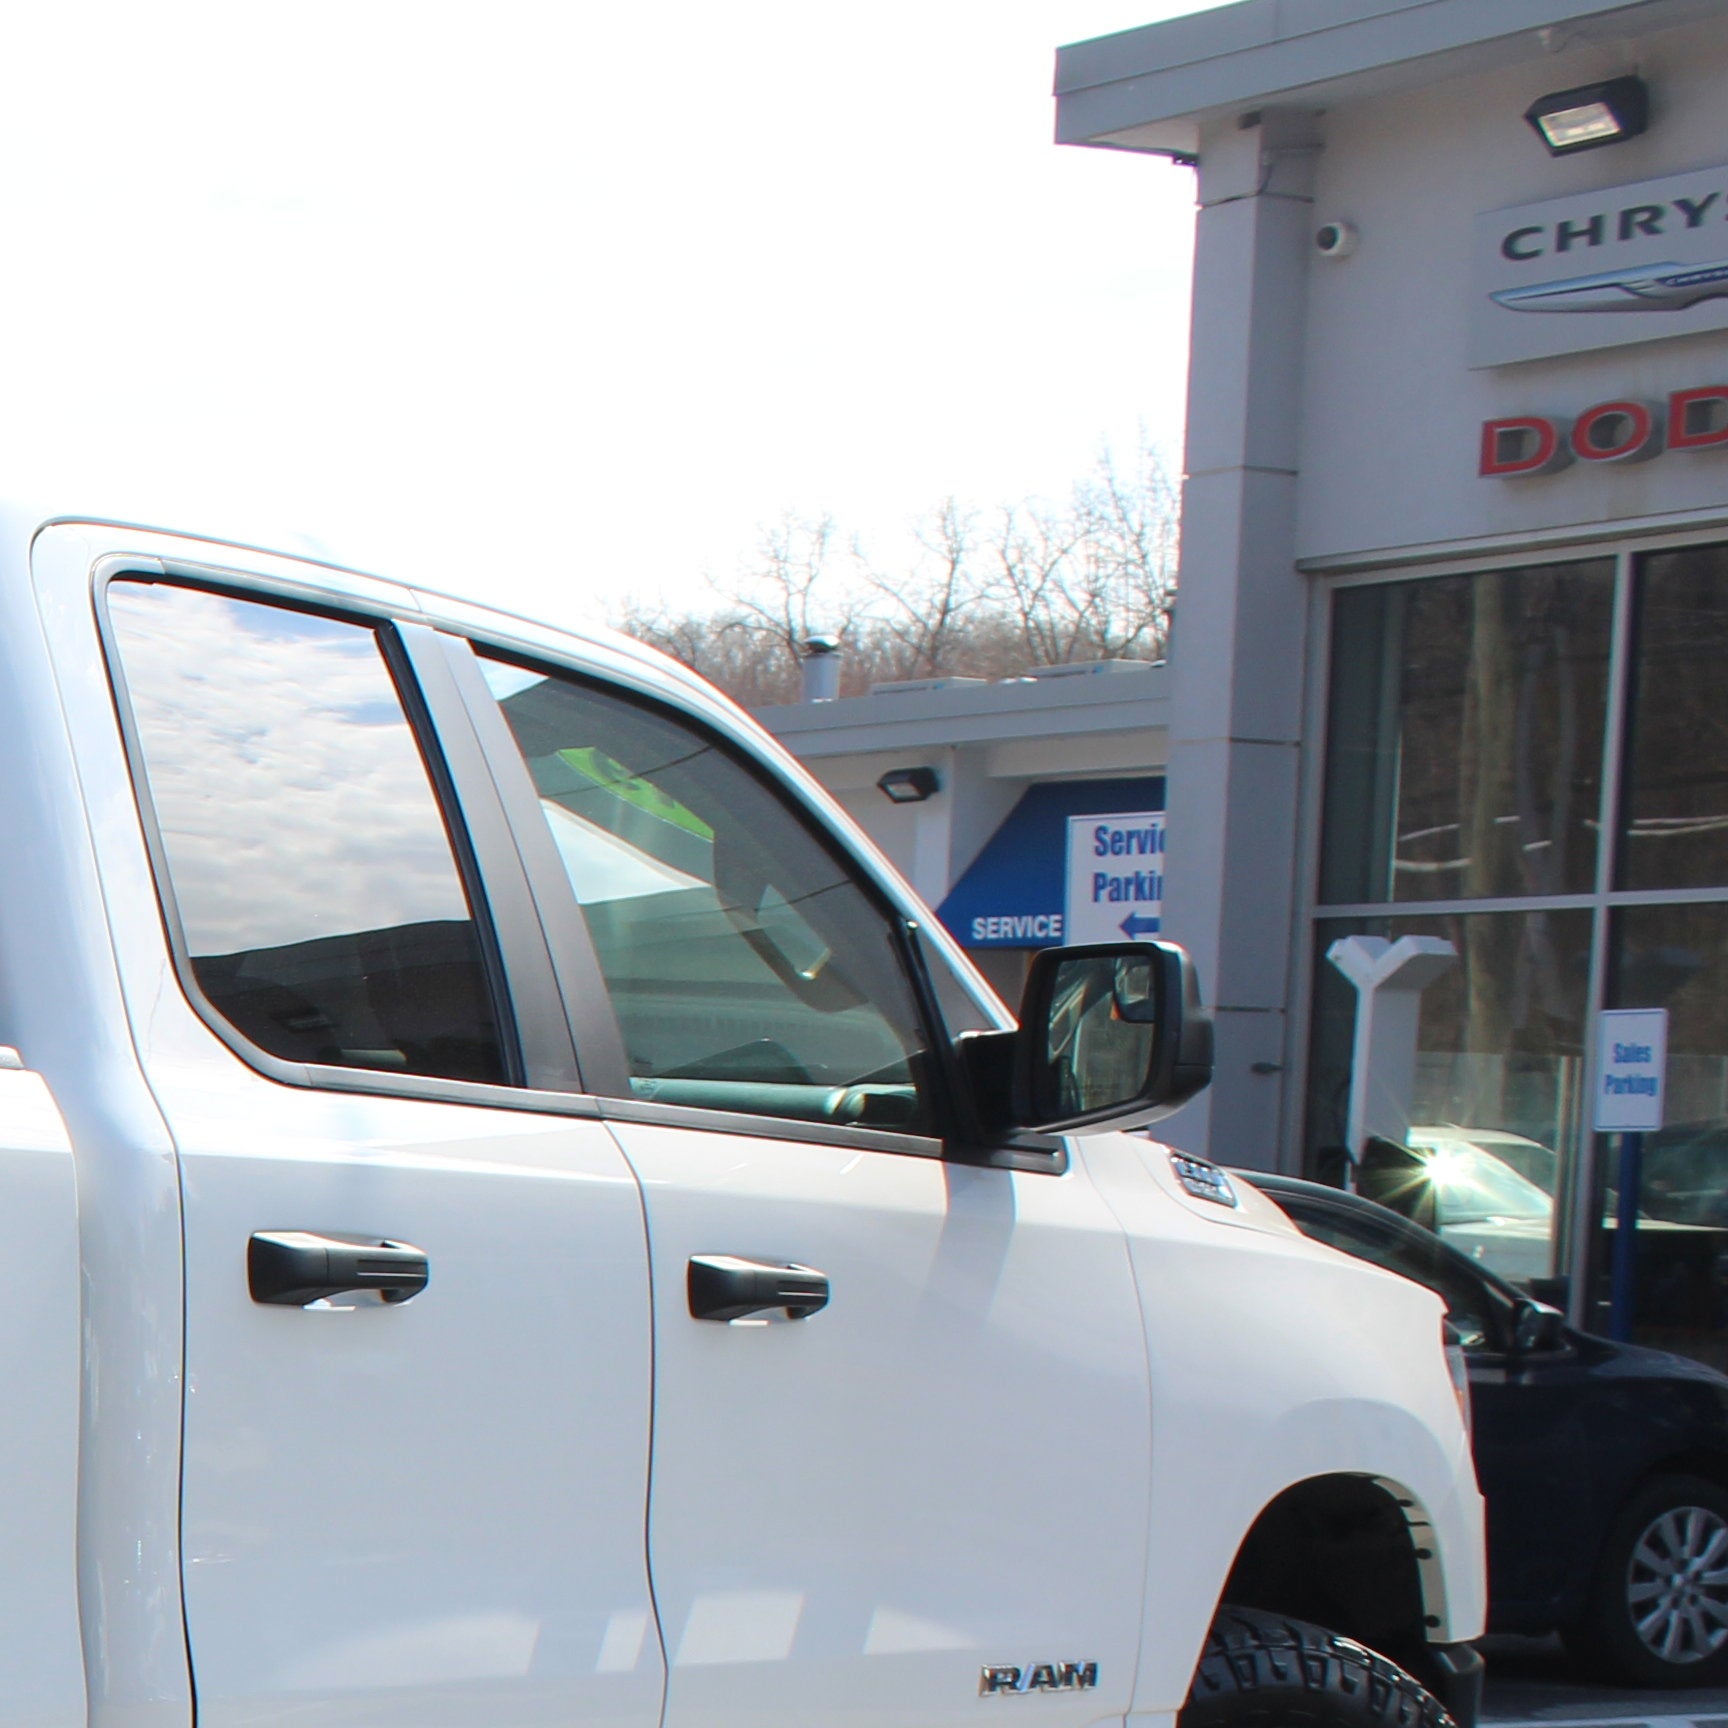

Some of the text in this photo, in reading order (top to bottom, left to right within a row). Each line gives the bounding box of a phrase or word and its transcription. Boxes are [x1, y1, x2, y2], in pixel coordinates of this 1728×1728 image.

[1501, 191, 1728, 262] CHRY
[1477, 386, 1728, 480] DOD
[972, 914, 1063, 942] SERVICE
[1614, 1042, 1652, 1063] Sales
[1604, 1074, 1659, 1097] Parking
[978, 1660, 1100, 1697] RAM
